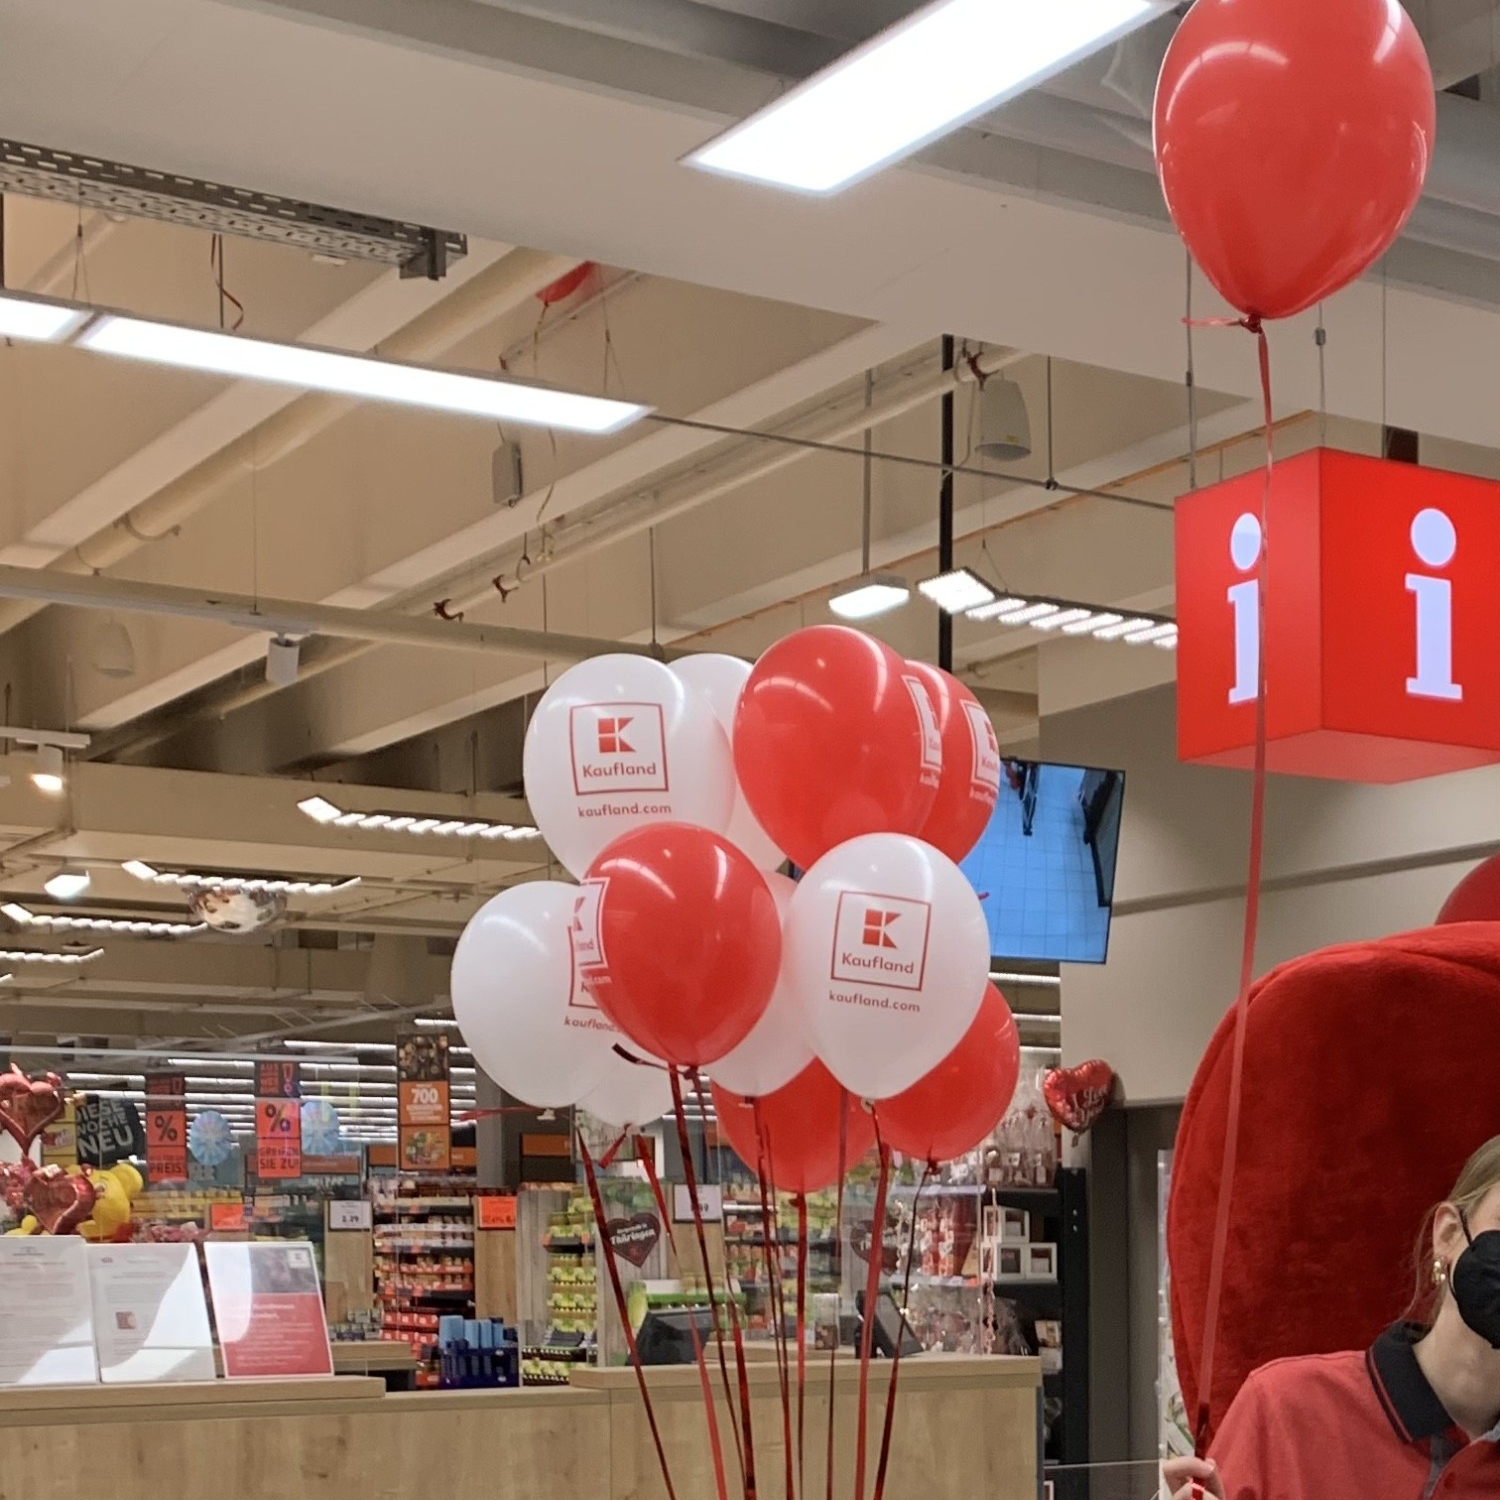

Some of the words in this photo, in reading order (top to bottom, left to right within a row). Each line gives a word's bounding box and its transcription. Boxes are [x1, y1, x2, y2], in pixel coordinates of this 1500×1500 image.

[1227, 512, 1262, 704] i
[1404, 507, 1463, 701] i
[583, 762, 657, 778] Kaufland
[578, 803, 672, 818] kaufland.com
[842, 952, 914, 975] Kaufland
[829, 989, 920, 1013] kaufland.com
[411, 1087, 439, 1104] 700
[77, 1124, 134, 1158] NEU
[260, 1158, 277, 1170] SIE
